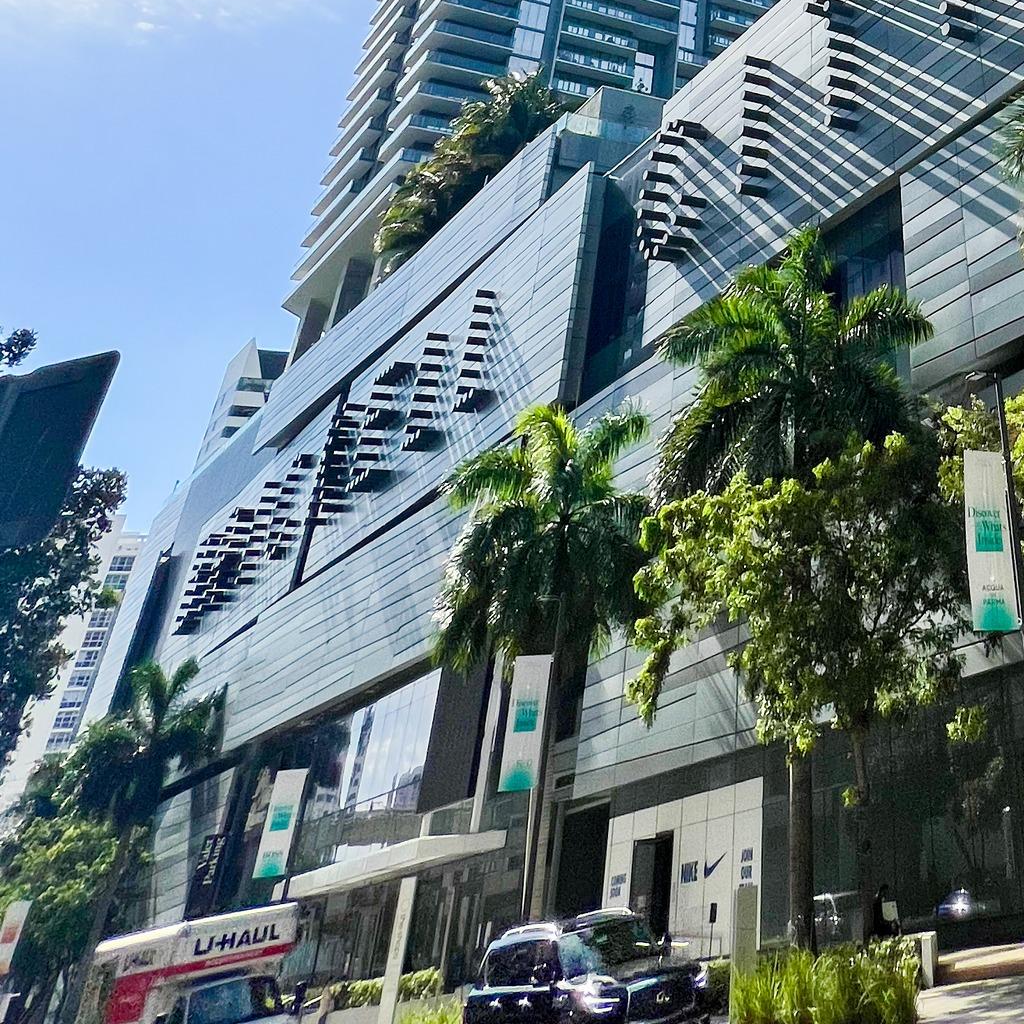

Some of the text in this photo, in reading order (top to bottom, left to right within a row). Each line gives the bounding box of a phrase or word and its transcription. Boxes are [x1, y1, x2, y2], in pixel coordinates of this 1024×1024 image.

[968, 507, 1000, 518] Discover
[982, 583, 1005, 592] ACQUA
[202, 836, 226, 886] Parking
[681, 861, 698, 883] NIKE
[193, 923, 280, 956] U-HAUL
